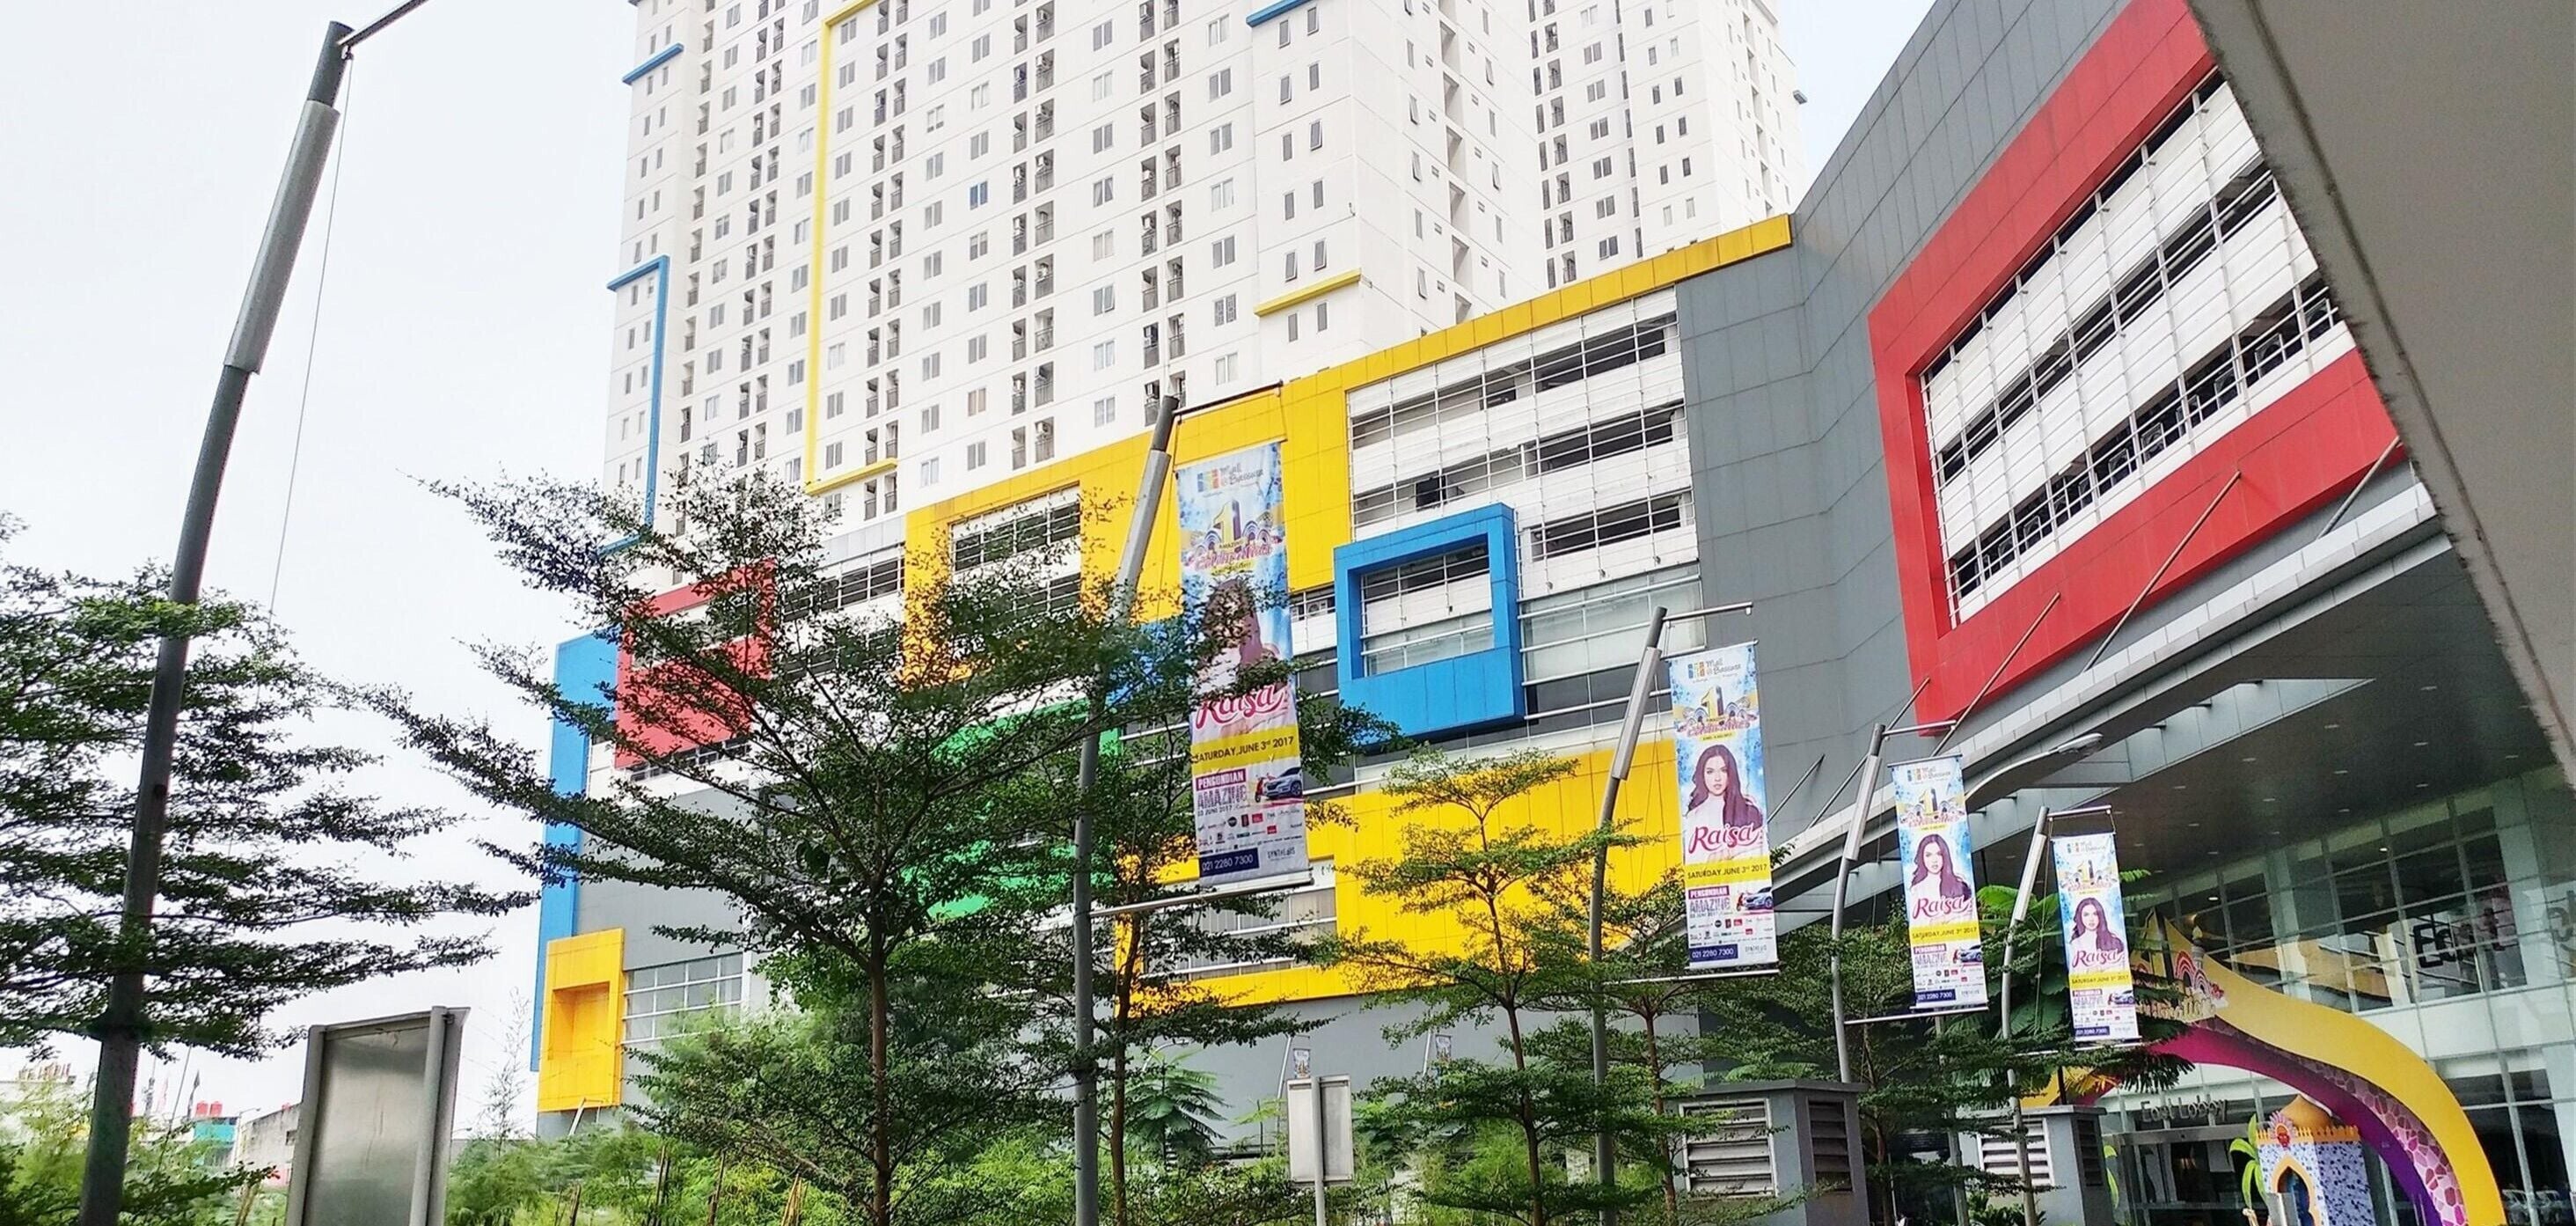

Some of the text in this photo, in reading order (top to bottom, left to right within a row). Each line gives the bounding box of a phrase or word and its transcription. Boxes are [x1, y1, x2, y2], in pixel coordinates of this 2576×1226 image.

[1273, 736, 1294, 748] 2017
[1197, 770, 1245, 789] PENGUNDIAN
[1688, 822, 1760, 855] Raisa
[1202, 862, 1213, 871] 021
[1234, 855, 1254, 866] 7300
[1723, 866, 1740, 876] JUNE
[1752, 863, 1767, 873] 2017
[1913, 894, 1972, 920] Raisa
[1692, 951, 1701, 959] 021
[2072, 948, 2124, 968] Raisa
[2140, 1093, 2228, 1123] East Lobby
